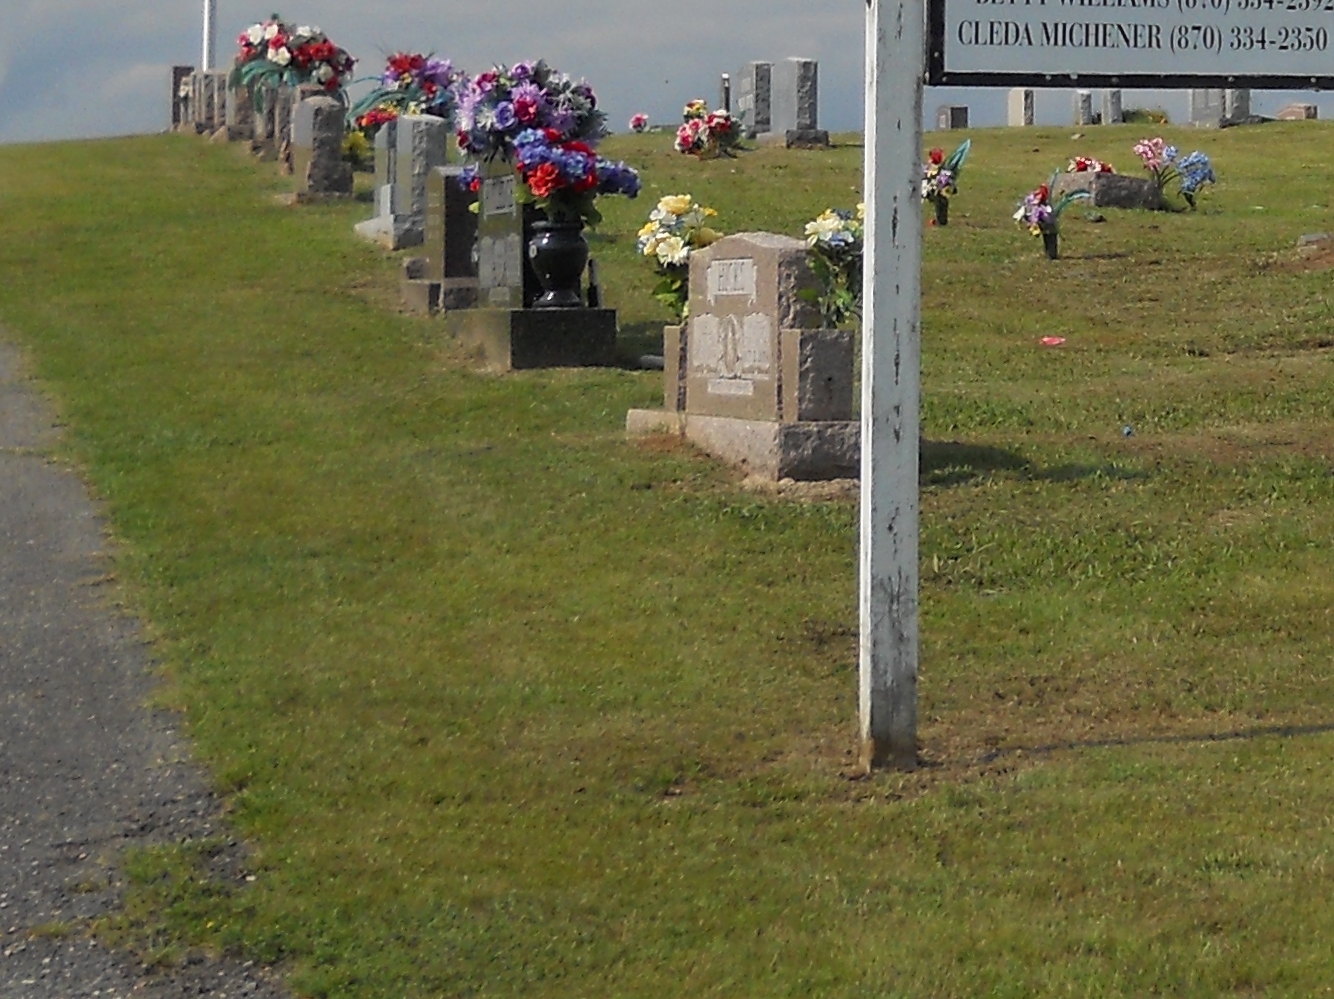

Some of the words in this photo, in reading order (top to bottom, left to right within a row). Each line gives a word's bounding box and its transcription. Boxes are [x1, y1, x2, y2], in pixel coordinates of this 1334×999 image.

[957, 19, 1034, 47] CLEDA
[1040, 21, 1163, 50] MICHENER
[1169, 24, 1223, 54] (870)
[1229, 25, 1328, 52] 334-2350
